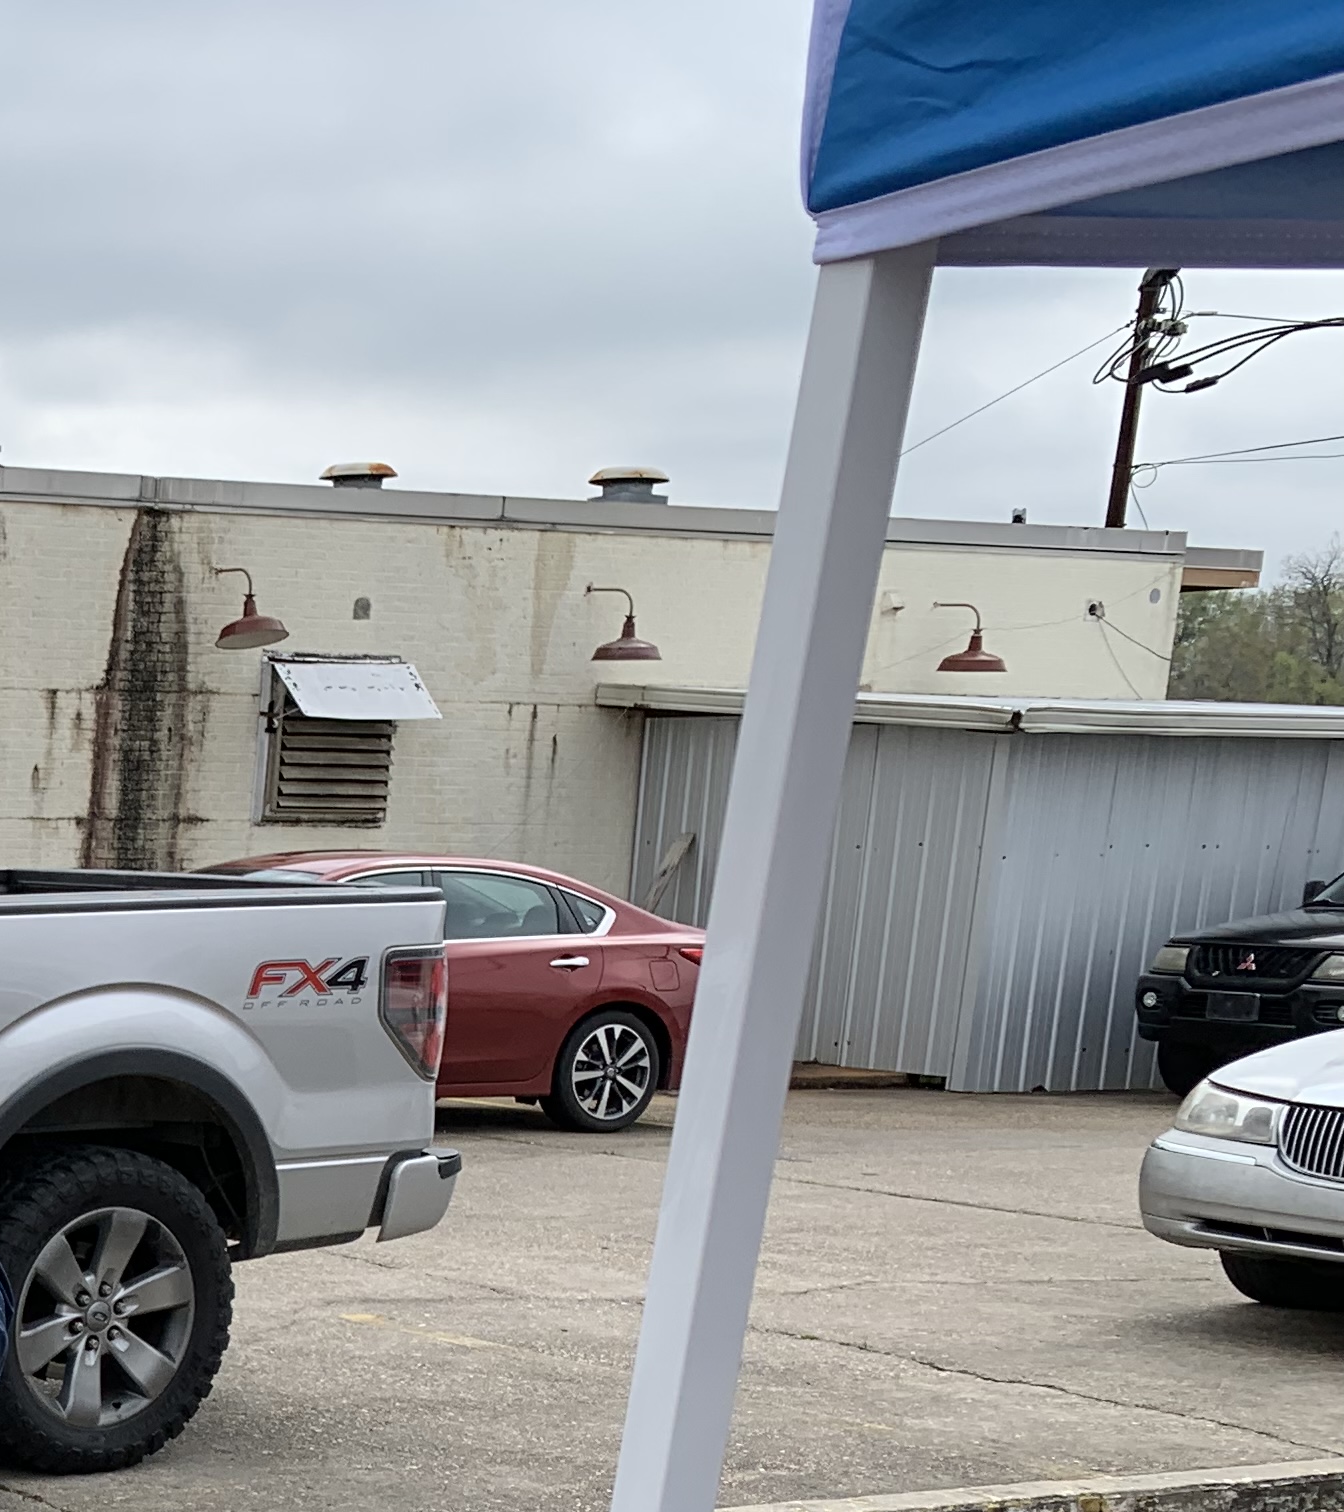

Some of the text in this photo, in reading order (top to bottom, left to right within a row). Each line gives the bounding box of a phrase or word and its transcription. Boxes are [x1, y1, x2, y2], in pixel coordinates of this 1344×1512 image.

[247, 955, 370, 999] FX4
[242, 997, 362, 1011] OFF ROAD
